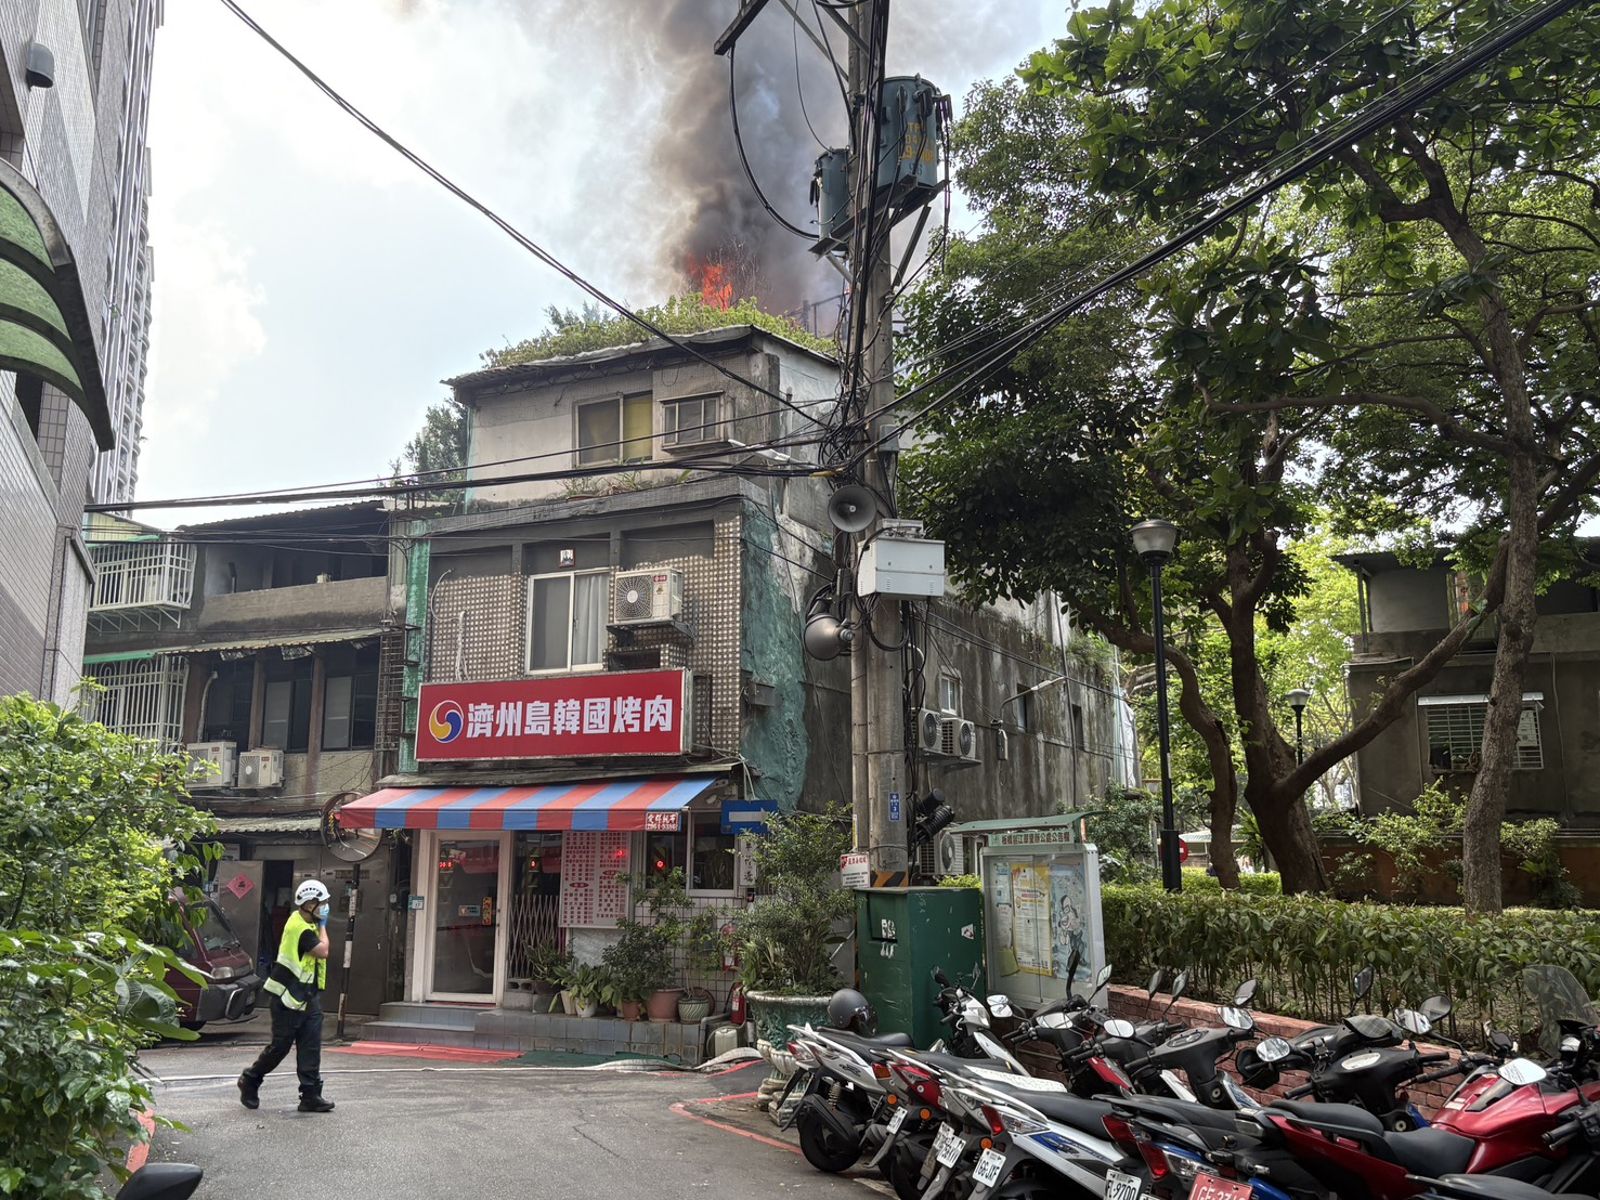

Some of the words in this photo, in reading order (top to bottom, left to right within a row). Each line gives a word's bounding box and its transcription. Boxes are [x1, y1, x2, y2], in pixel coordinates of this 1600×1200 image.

[466, 694, 673, 739] 濟州島韓國烤肉
